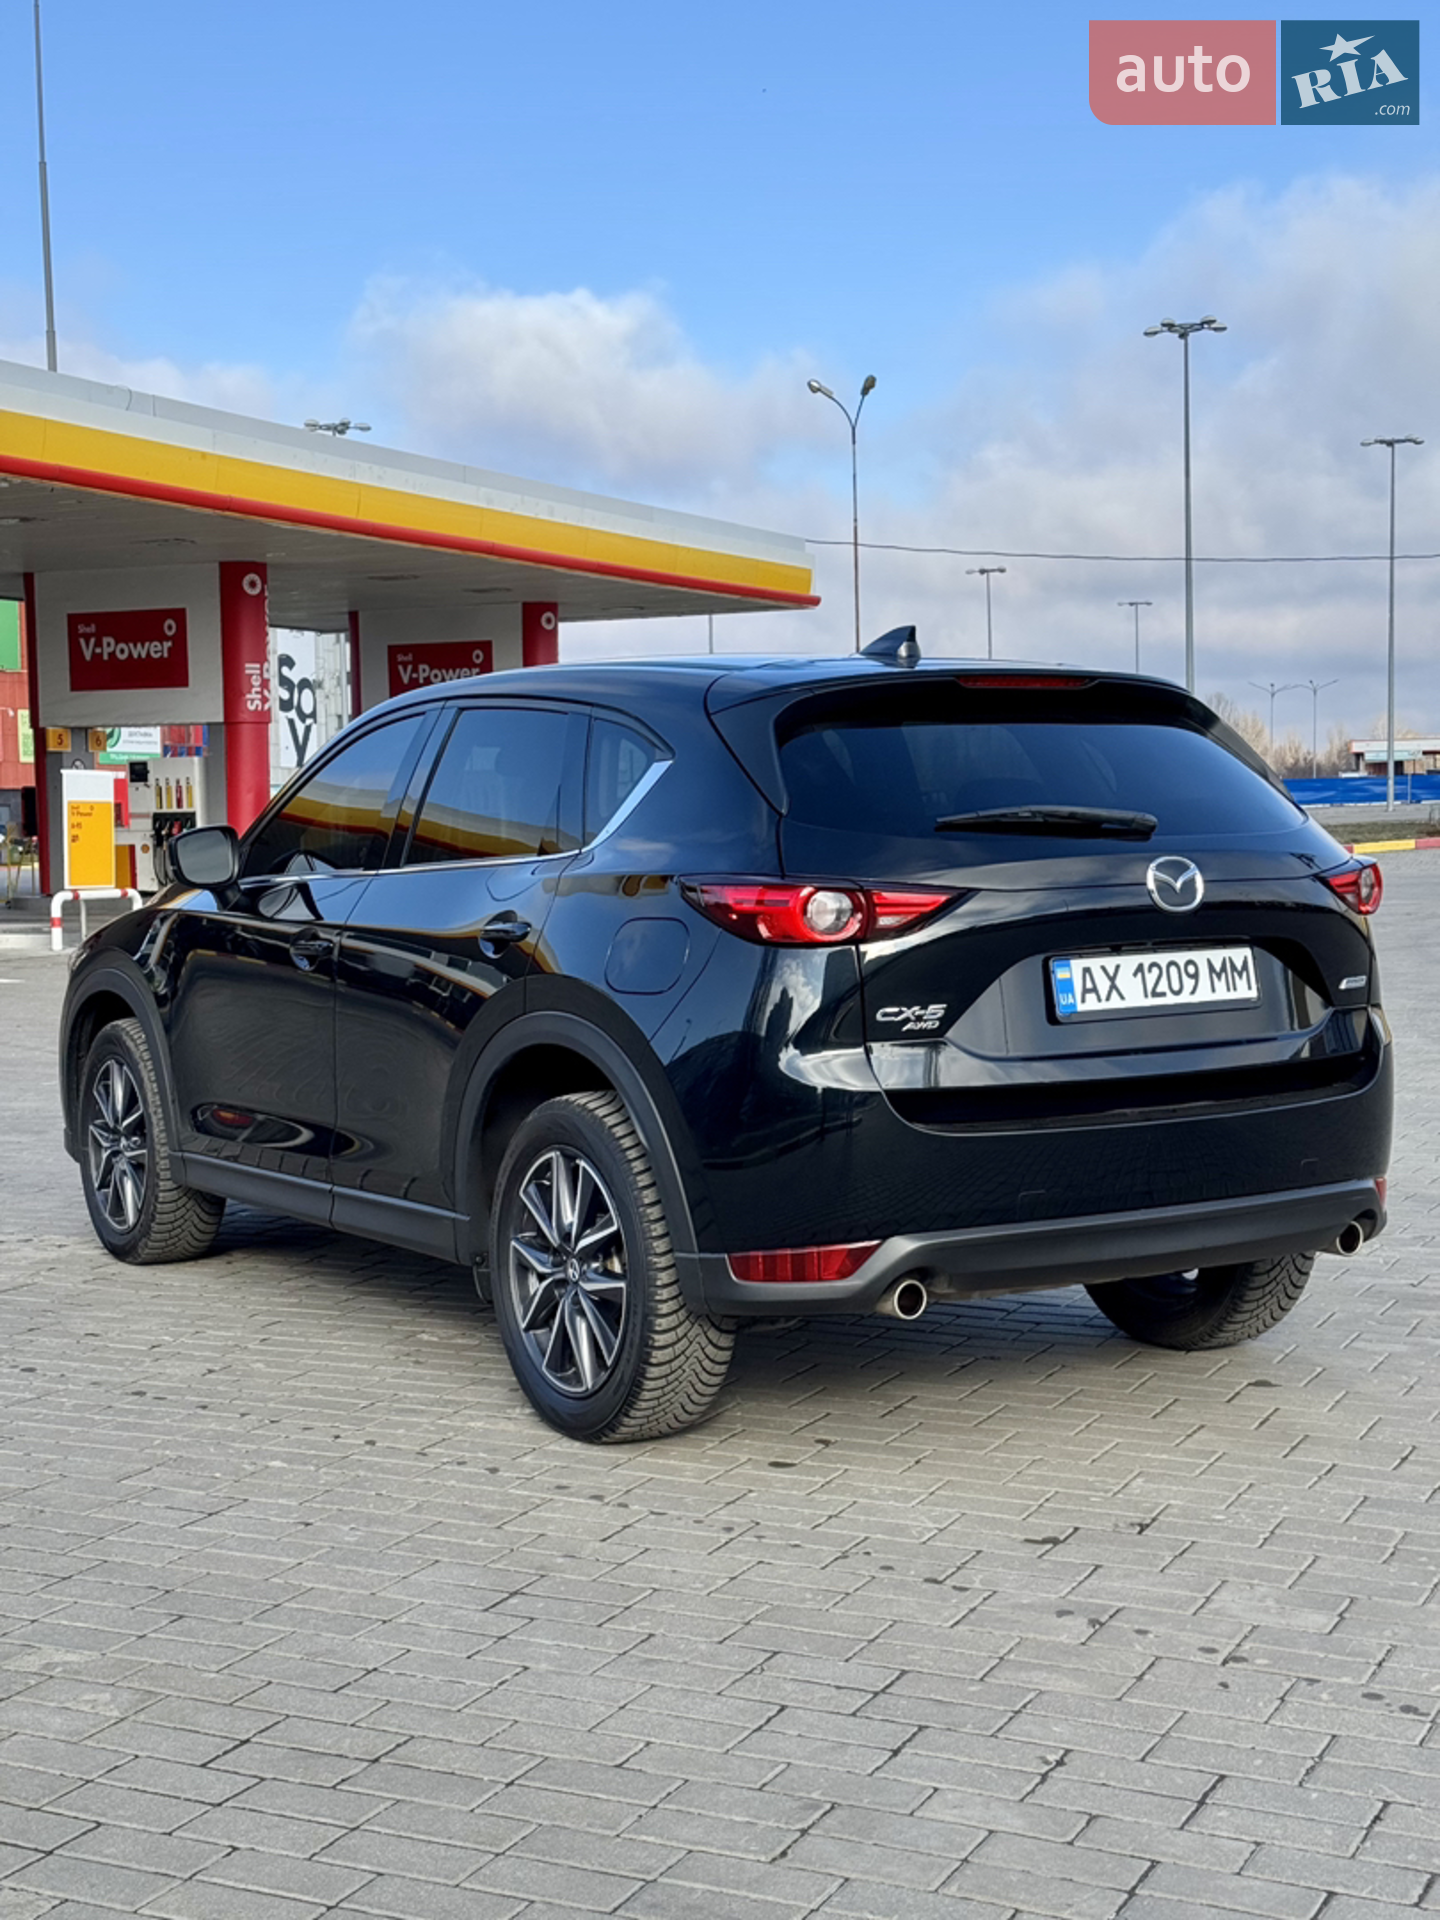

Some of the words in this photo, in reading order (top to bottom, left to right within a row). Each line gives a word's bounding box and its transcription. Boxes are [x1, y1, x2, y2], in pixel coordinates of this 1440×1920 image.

[78, 623, 96, 634] Shell
[79, 636, 173, 662] V-Power
[397, 652, 413, 662] Shell
[398, 664, 480, 685] V-Power
[245, 663, 262, 711] Shell
[56, 734, 64, 746] 5
[95, 735, 102, 747] 6
[1080, 963, 1126, 1005] AX
[1132, 958, 1201, 999] 1209
[1206, 954, 1253, 994] MM
[1059, 993, 1075, 1006] UA
[876, 1003, 947, 1022] CX-5
[901, 1020, 940, 1032] AWD
